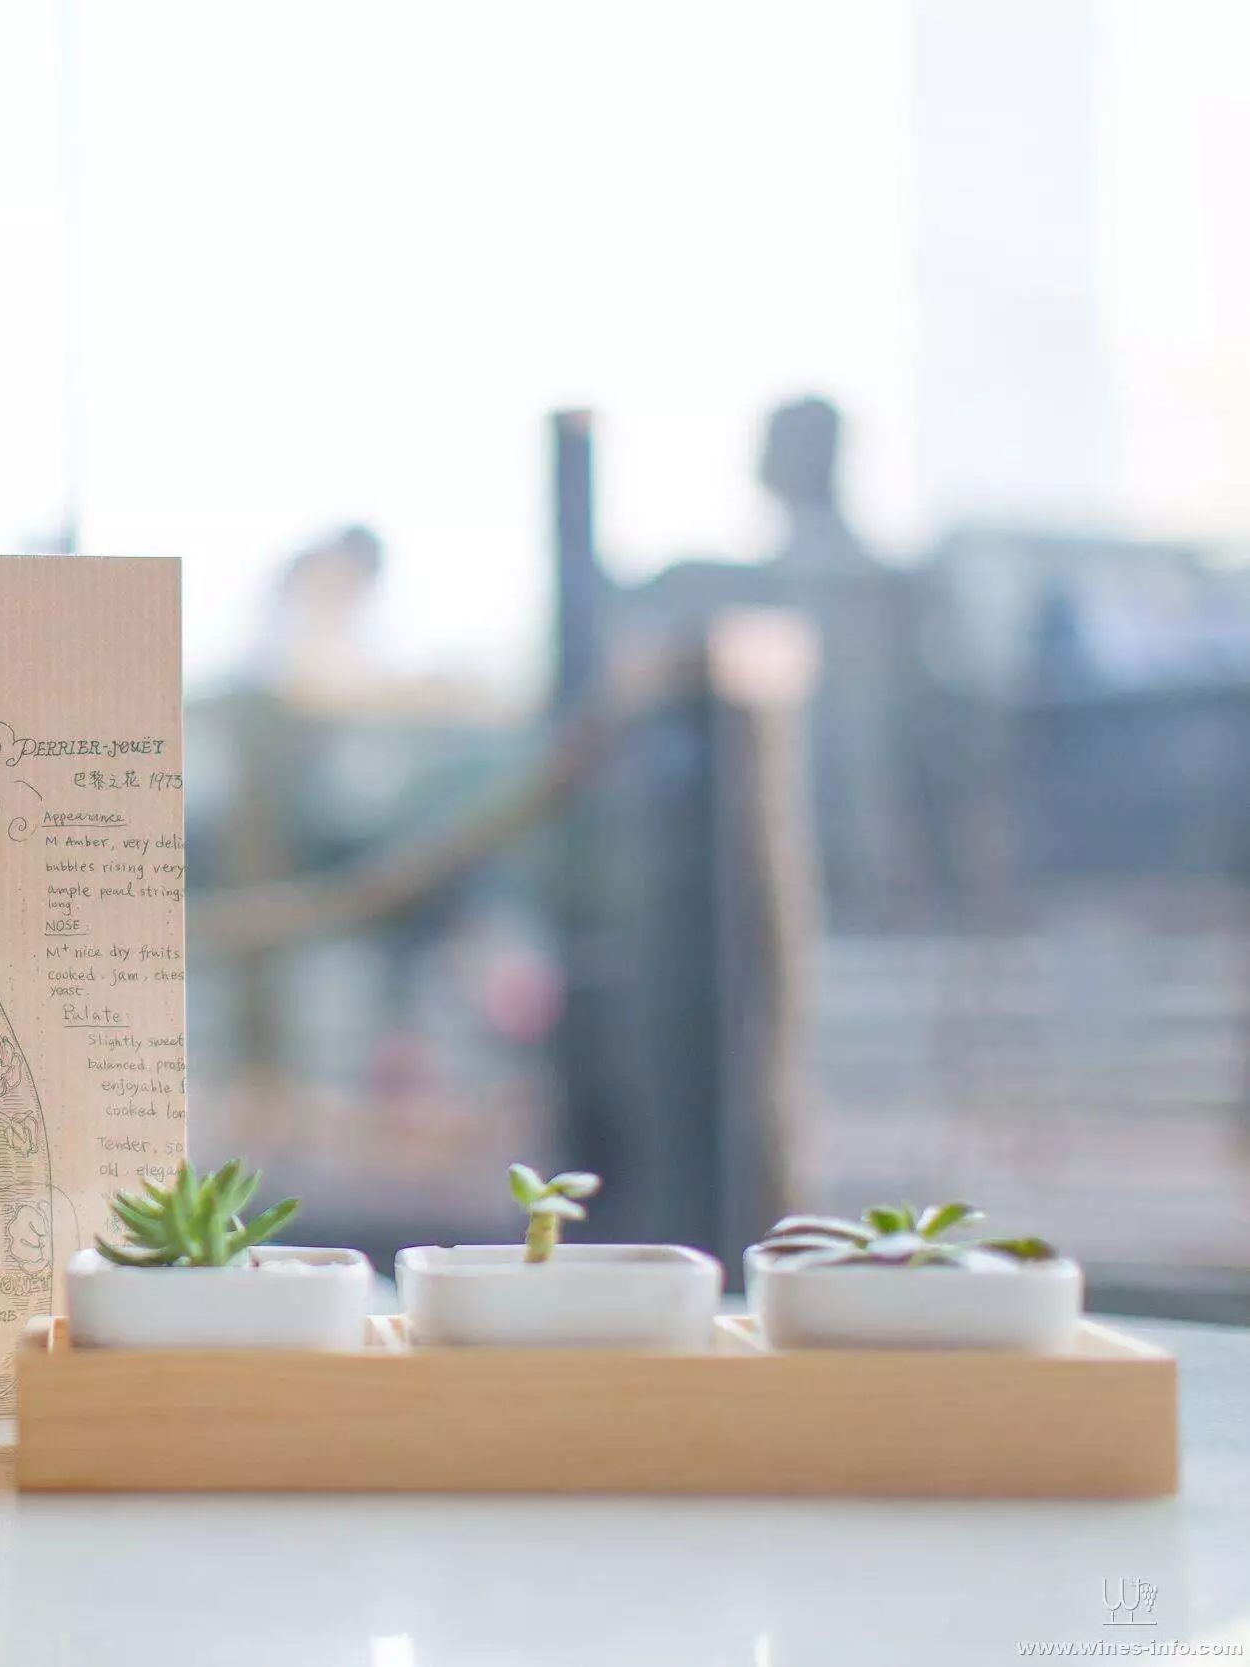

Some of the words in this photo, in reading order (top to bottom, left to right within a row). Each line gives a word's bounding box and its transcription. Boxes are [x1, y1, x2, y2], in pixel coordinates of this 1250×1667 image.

[74, 771, 140, 790] 巴黎之花
[123, 839, 149, 856] very
[46, 860, 94, 872] bubbles
[103, 861, 144, 879] rising
[153, 864, 184, 879] very
[48, 882, 91, 898] ample
[100, 881, 135, 899] pearl
[75, 946, 101, 958] nice
[110, 945, 130, 961] dry
[102, 1079, 172, 1097] enjoyable
